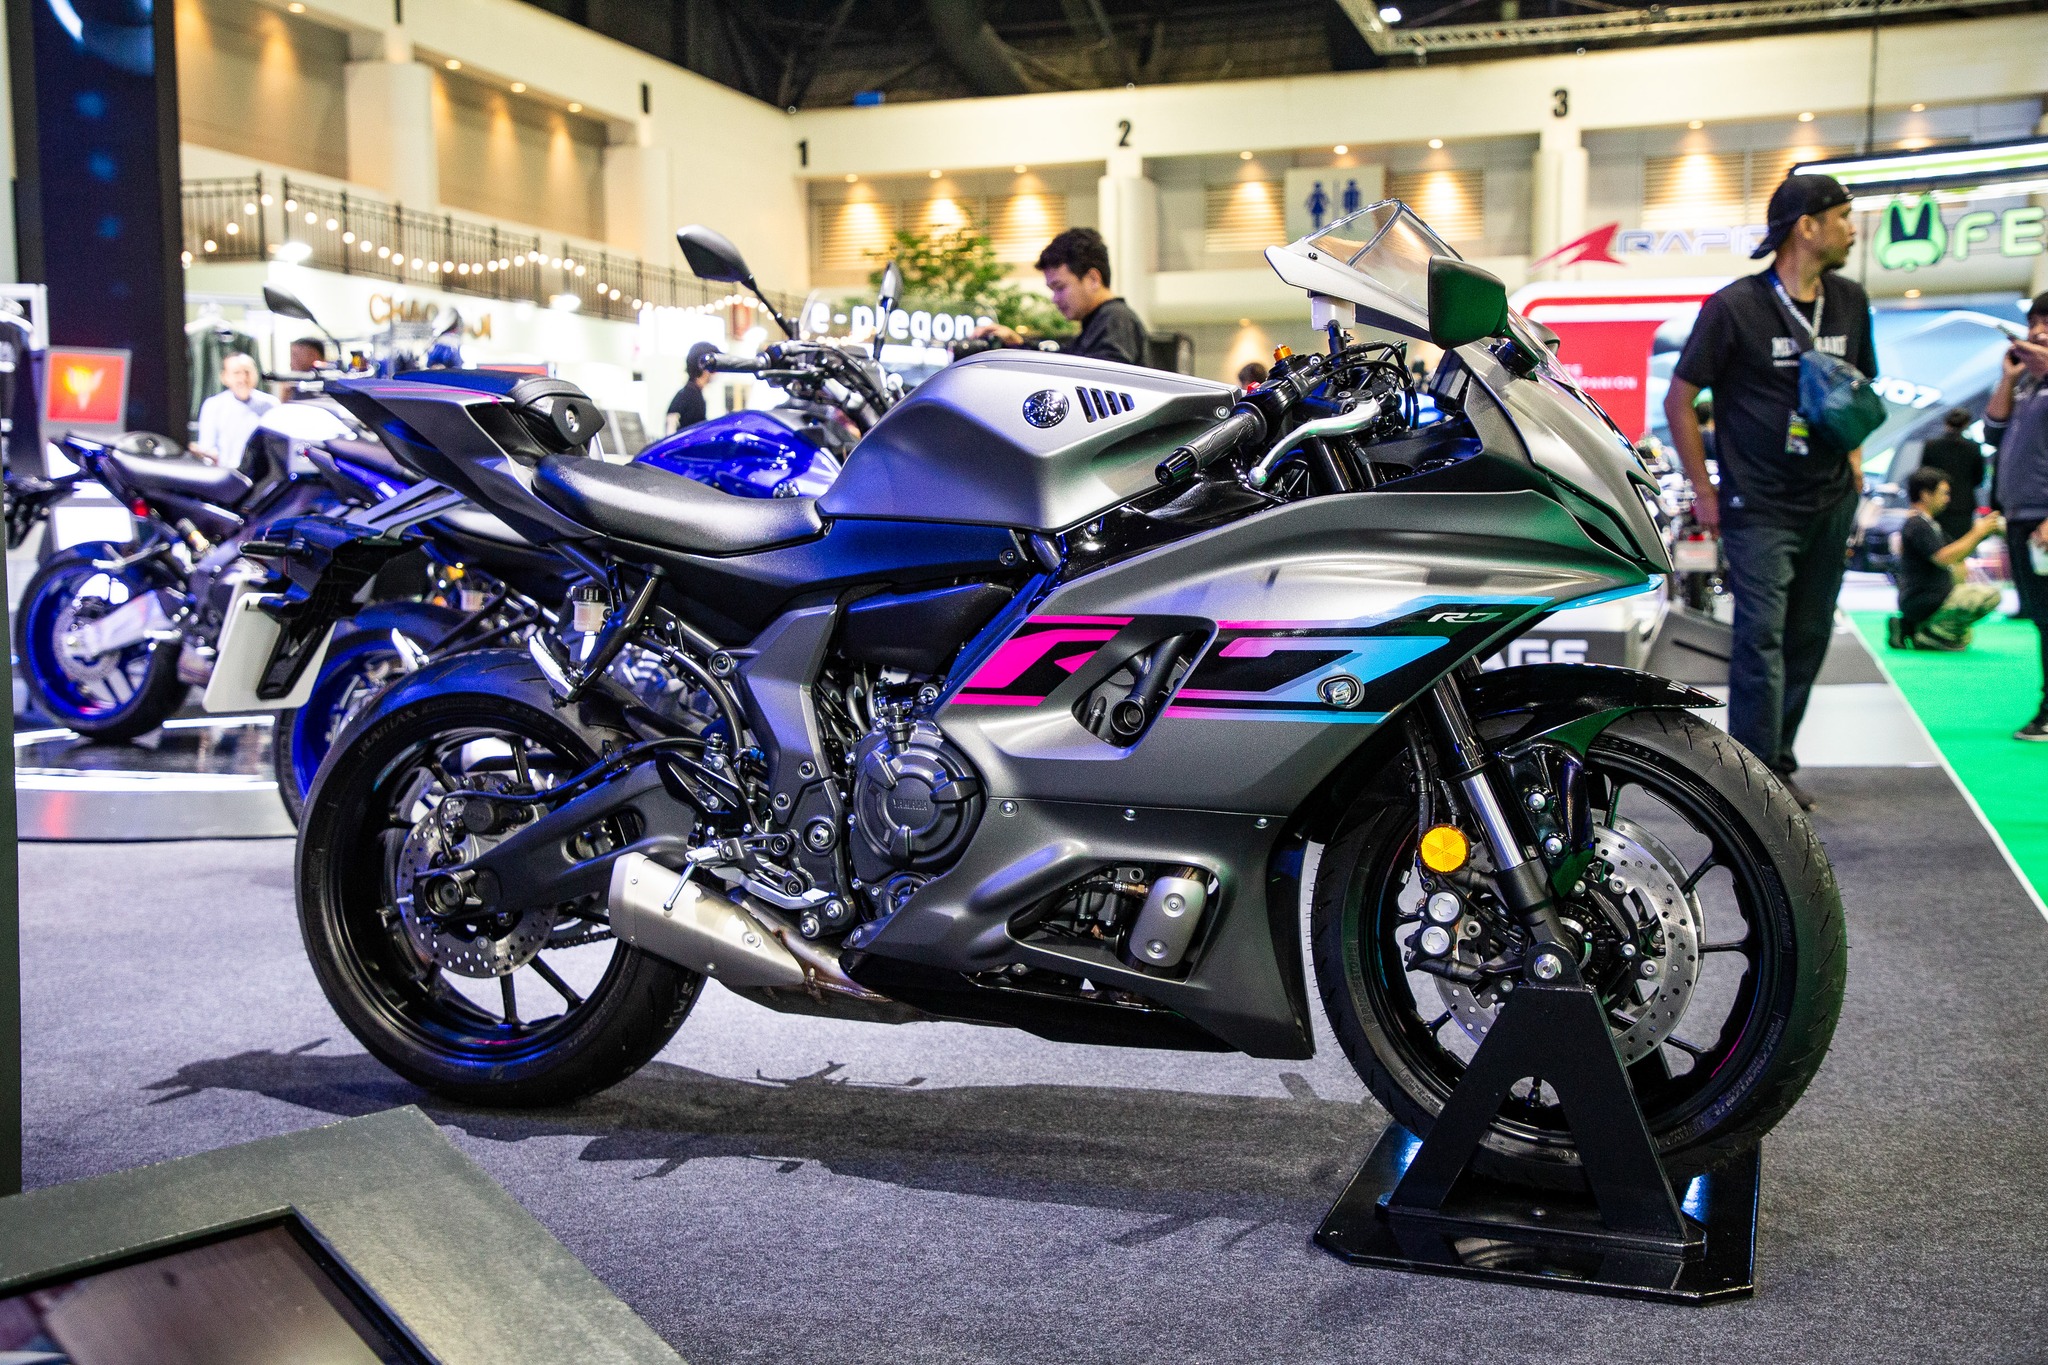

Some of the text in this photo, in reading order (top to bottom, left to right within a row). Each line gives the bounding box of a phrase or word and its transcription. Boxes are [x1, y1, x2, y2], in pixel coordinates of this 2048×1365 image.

[1553, 89, 1568, 118] 3
[1118, 119, 1132, 147] 2
[797, 139, 808, 168] 1
[1953, 206, 2046, 261] FE
[1427, 612, 1503, 623] R7
